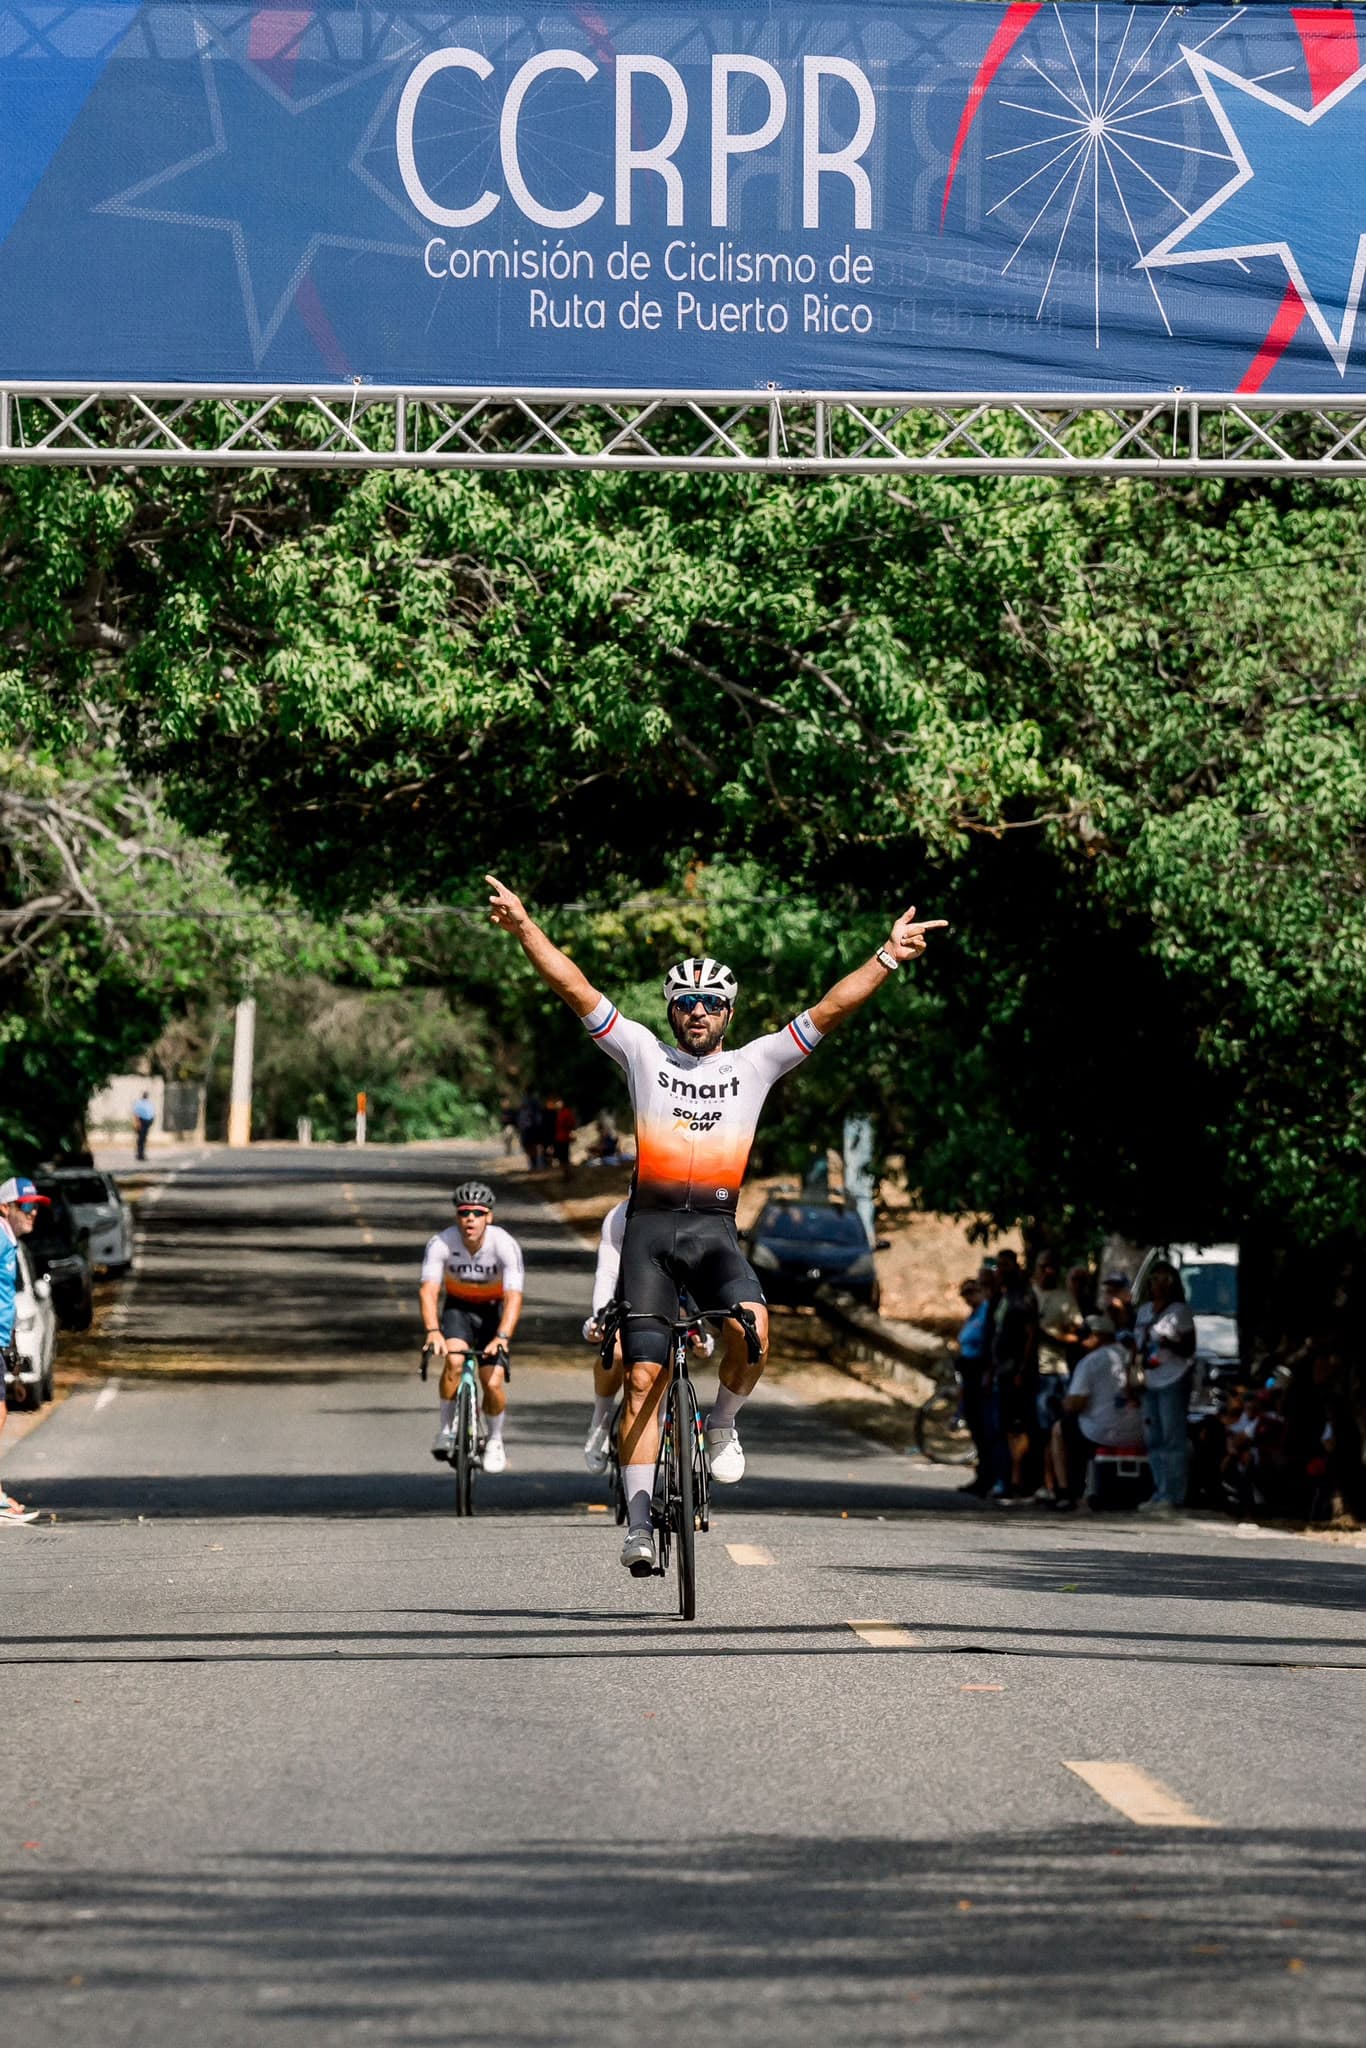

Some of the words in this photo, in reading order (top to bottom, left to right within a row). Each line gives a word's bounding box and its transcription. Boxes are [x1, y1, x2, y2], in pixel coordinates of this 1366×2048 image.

[396, 47, 877, 230] CCRPR
[424, 237, 594, 279] Comisión
[607, 240, 651, 280] de
[664, 240, 816, 283] Ciclismo
[829, 244, 874, 284] de
[530, 289, 605, 328] Ruta
[618, 290, 663, 330] de
[677, 291, 788, 333] Puerto
[804, 293, 873, 333] Rico
[658, 1071, 739, 1099] smart
[672, 1107, 722, 1121] SOLAR
